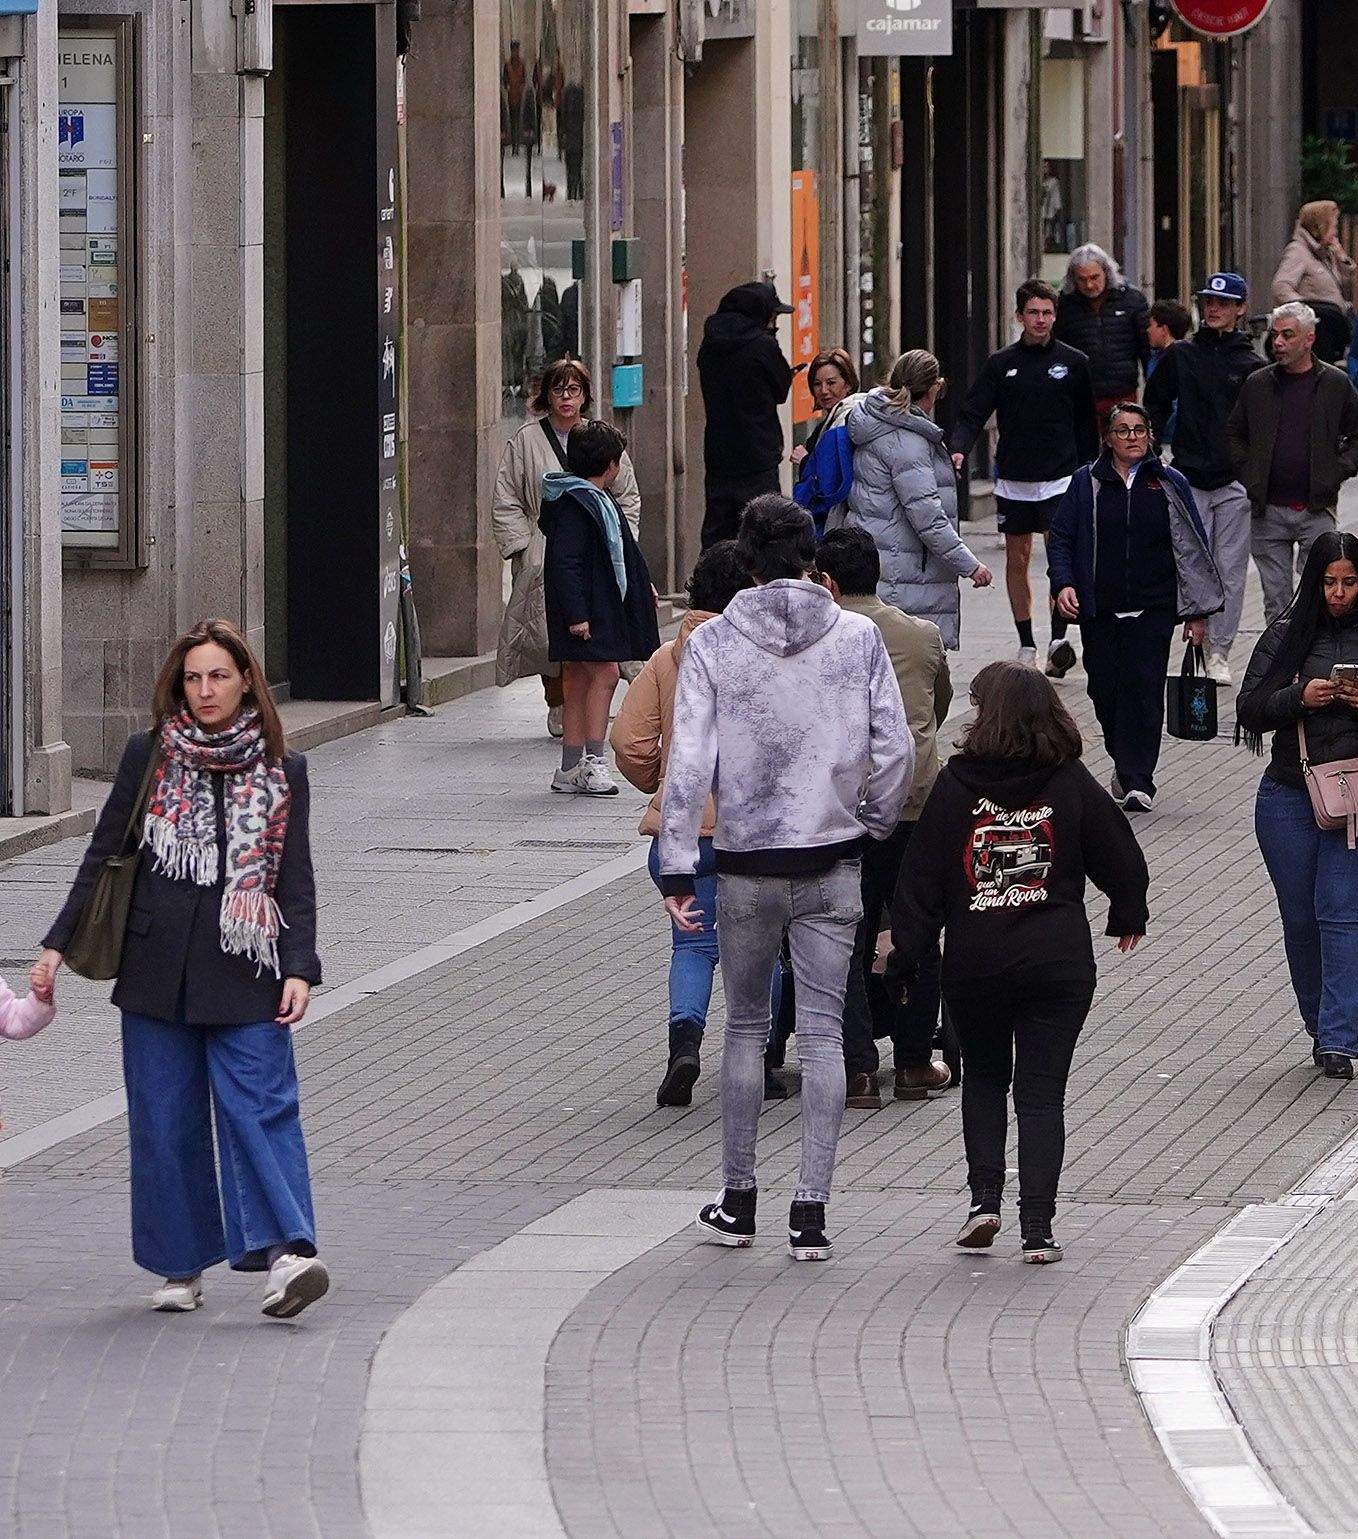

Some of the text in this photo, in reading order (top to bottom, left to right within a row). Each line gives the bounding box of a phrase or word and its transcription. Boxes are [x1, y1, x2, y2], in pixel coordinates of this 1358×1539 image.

[865, 14, 942, 35] cajamar
[61, 77, 67, 88] 1
[995, 811, 1010, 821] de
[1003, 806, 1053, 828] Monte
[976, 881, 996, 892] que
[969, 886, 1048, 911] Land Rover
